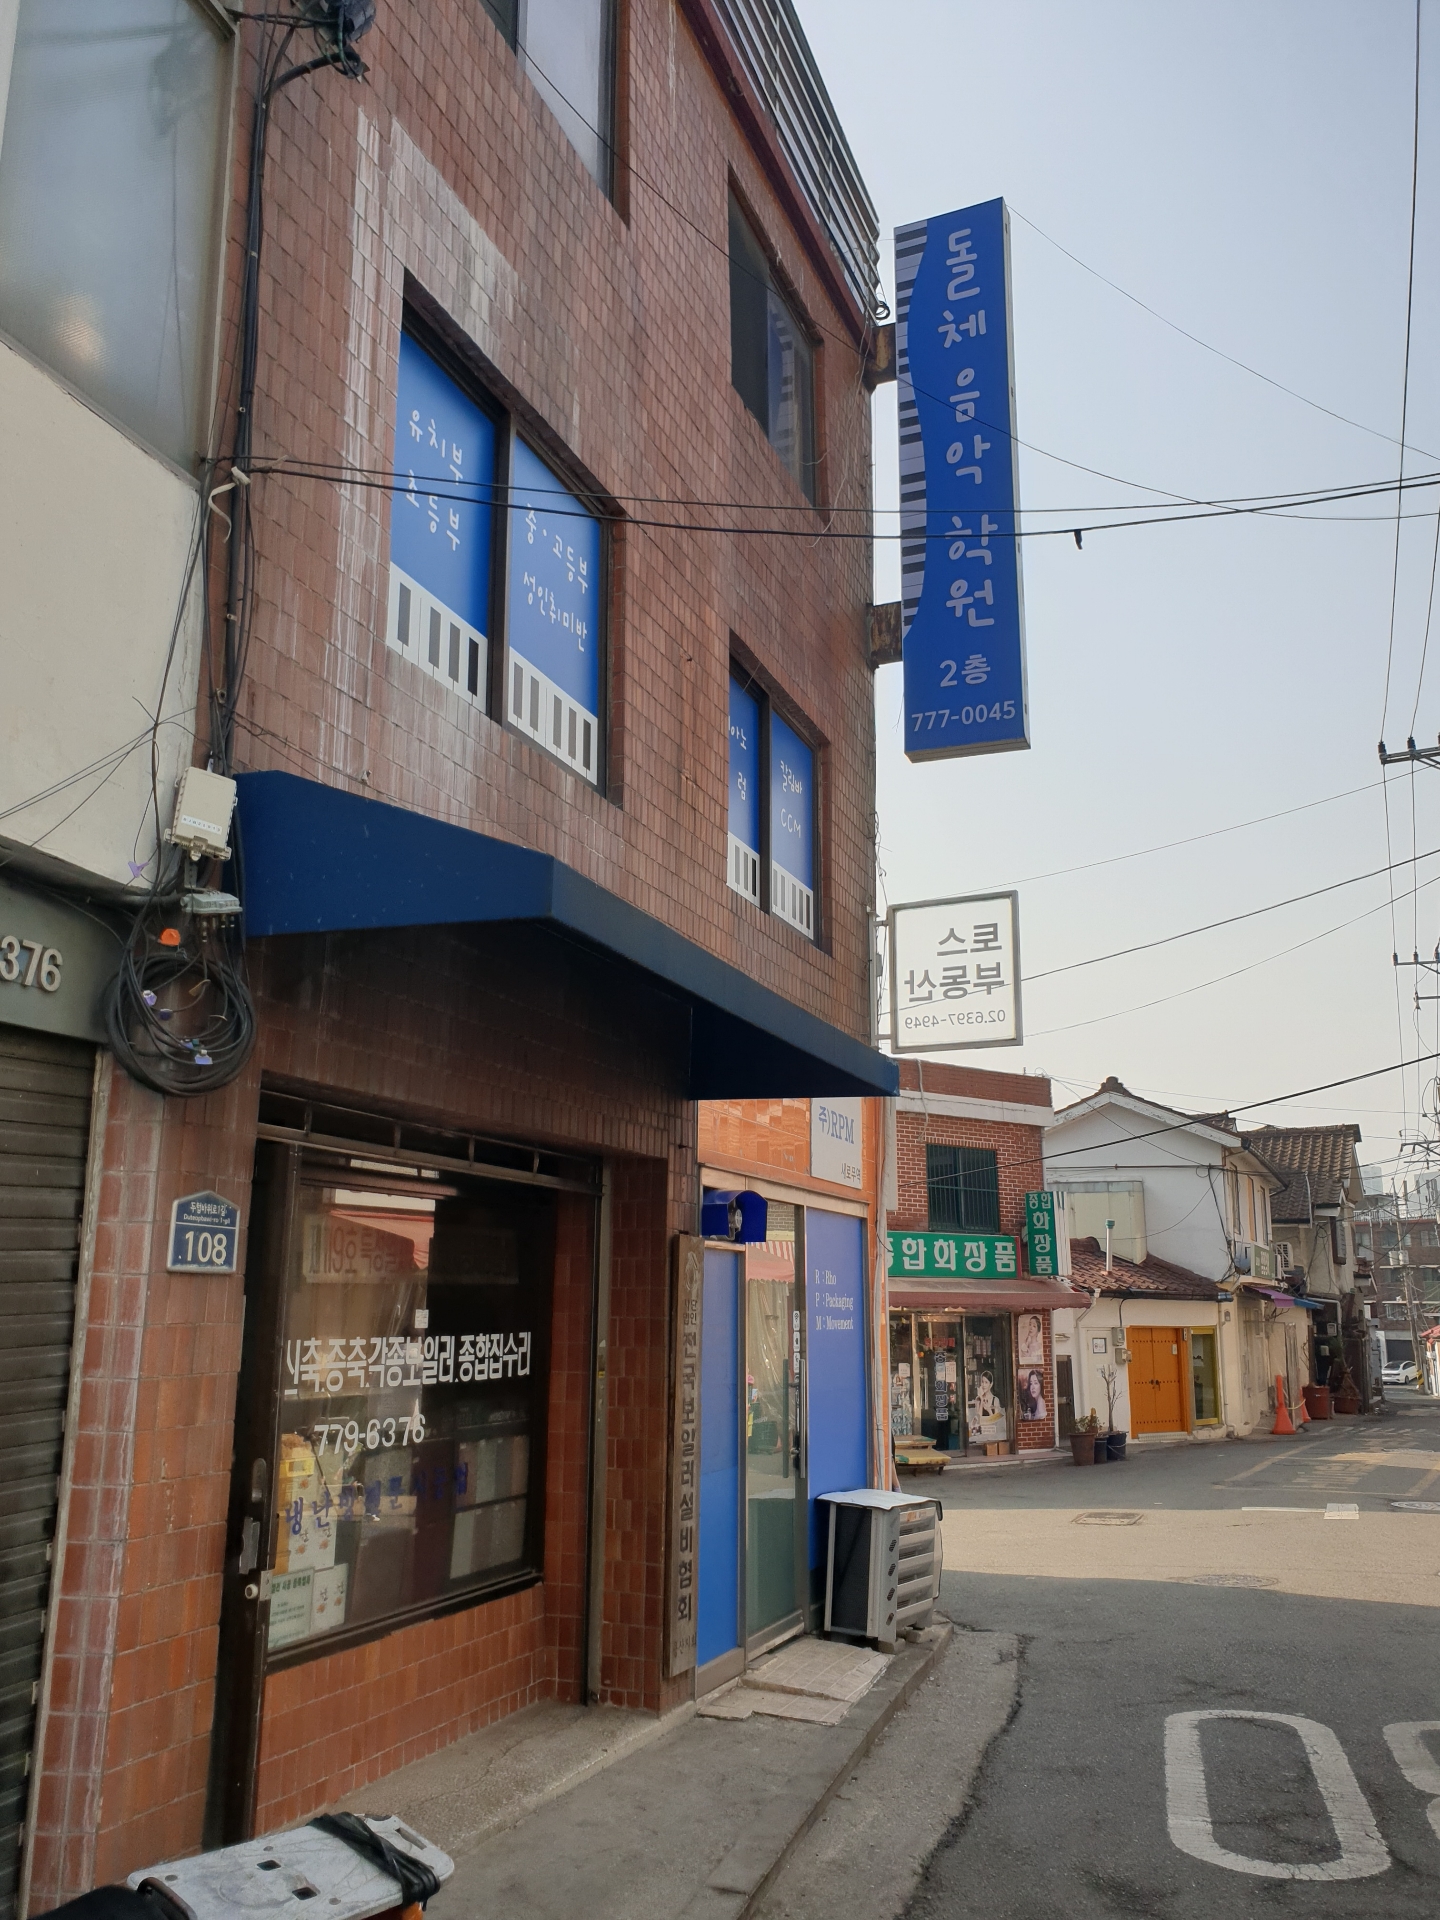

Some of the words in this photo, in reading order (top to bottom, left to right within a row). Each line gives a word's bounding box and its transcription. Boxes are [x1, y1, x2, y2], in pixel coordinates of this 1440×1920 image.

[409, 410, 463, 486] 유치부
[406, 469, 461, 551] 초등부
[523, 571, 588, 653] 성인취미반
[939, 653, 991, 688] 2층
[911, 700, 1016, 732] 777-0045
[780, 807, 801, 839] CCM
[0, 935, 63, 992] 376
[185, 1230, 227, 1264] 108
[313, 1413, 426, 1457] 779-6376
